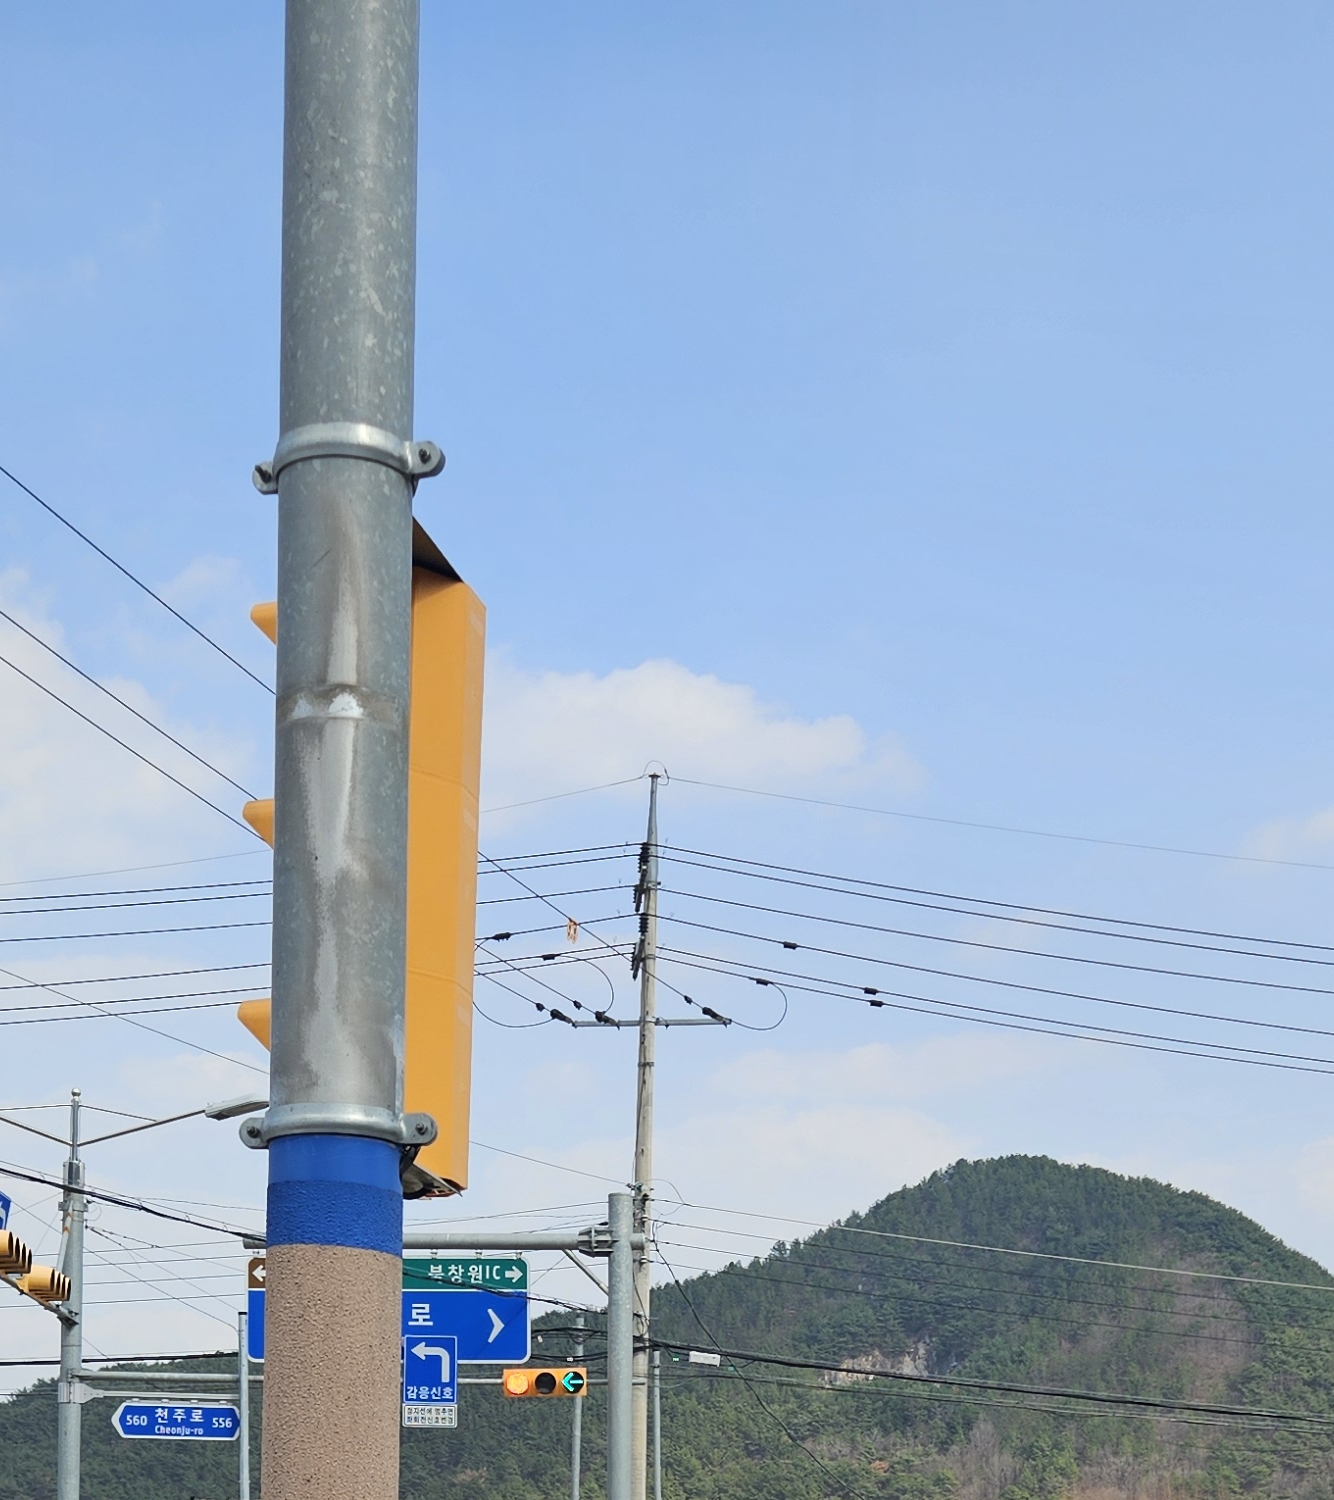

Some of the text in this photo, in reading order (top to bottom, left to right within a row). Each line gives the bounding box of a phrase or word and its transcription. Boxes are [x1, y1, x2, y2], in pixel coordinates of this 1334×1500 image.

[406, 1385, 454, 1400] 감응신호
[125, 1414, 148, 1426] 560
[154, 1407, 205, 1424] 천주로
[211, 1417, 233, 1428] 556
[154, 1425, 204, 1436] Cheonju-ro
